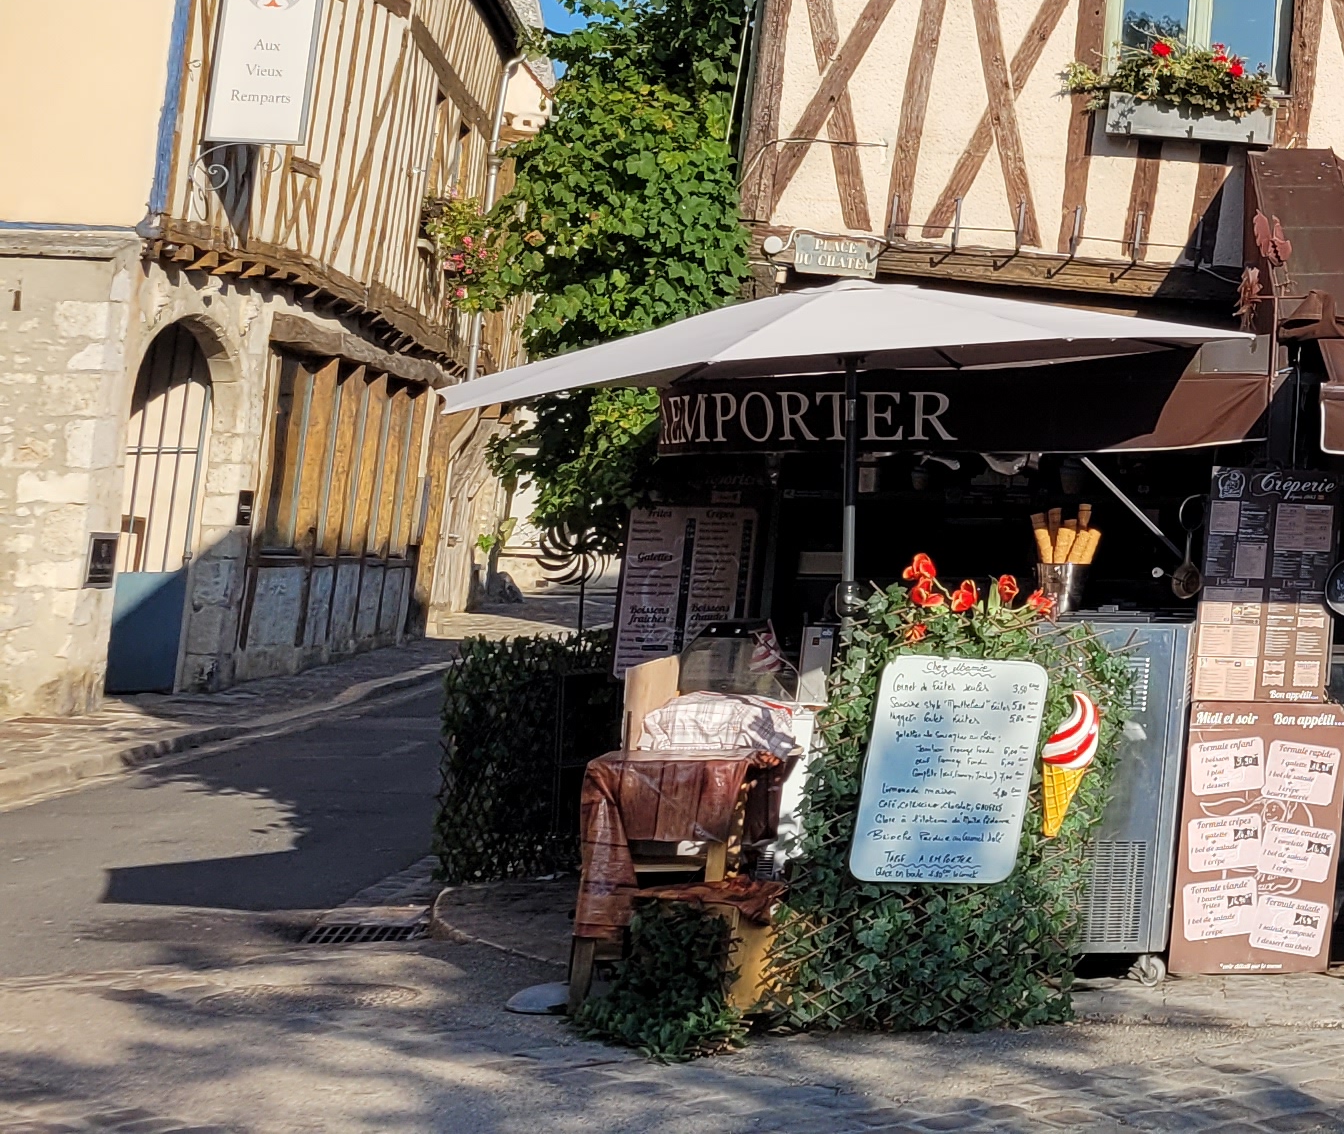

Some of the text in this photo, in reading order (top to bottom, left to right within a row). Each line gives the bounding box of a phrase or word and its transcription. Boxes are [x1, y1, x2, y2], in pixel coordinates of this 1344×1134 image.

[253, 38, 281, 52] Aux
[246, 63, 283, 77] Vieux
[230, 89, 291, 106] Remparts
[814, 238, 858, 254] PLACE
[795, 252, 872, 271] DU CHATEL
[1261, 471, 1337, 500] Crêperie
[1196, 711, 1223, 725] Midi
[1235, 712, 1259, 725] soir
[1273, 712, 1295, 726] Bon
